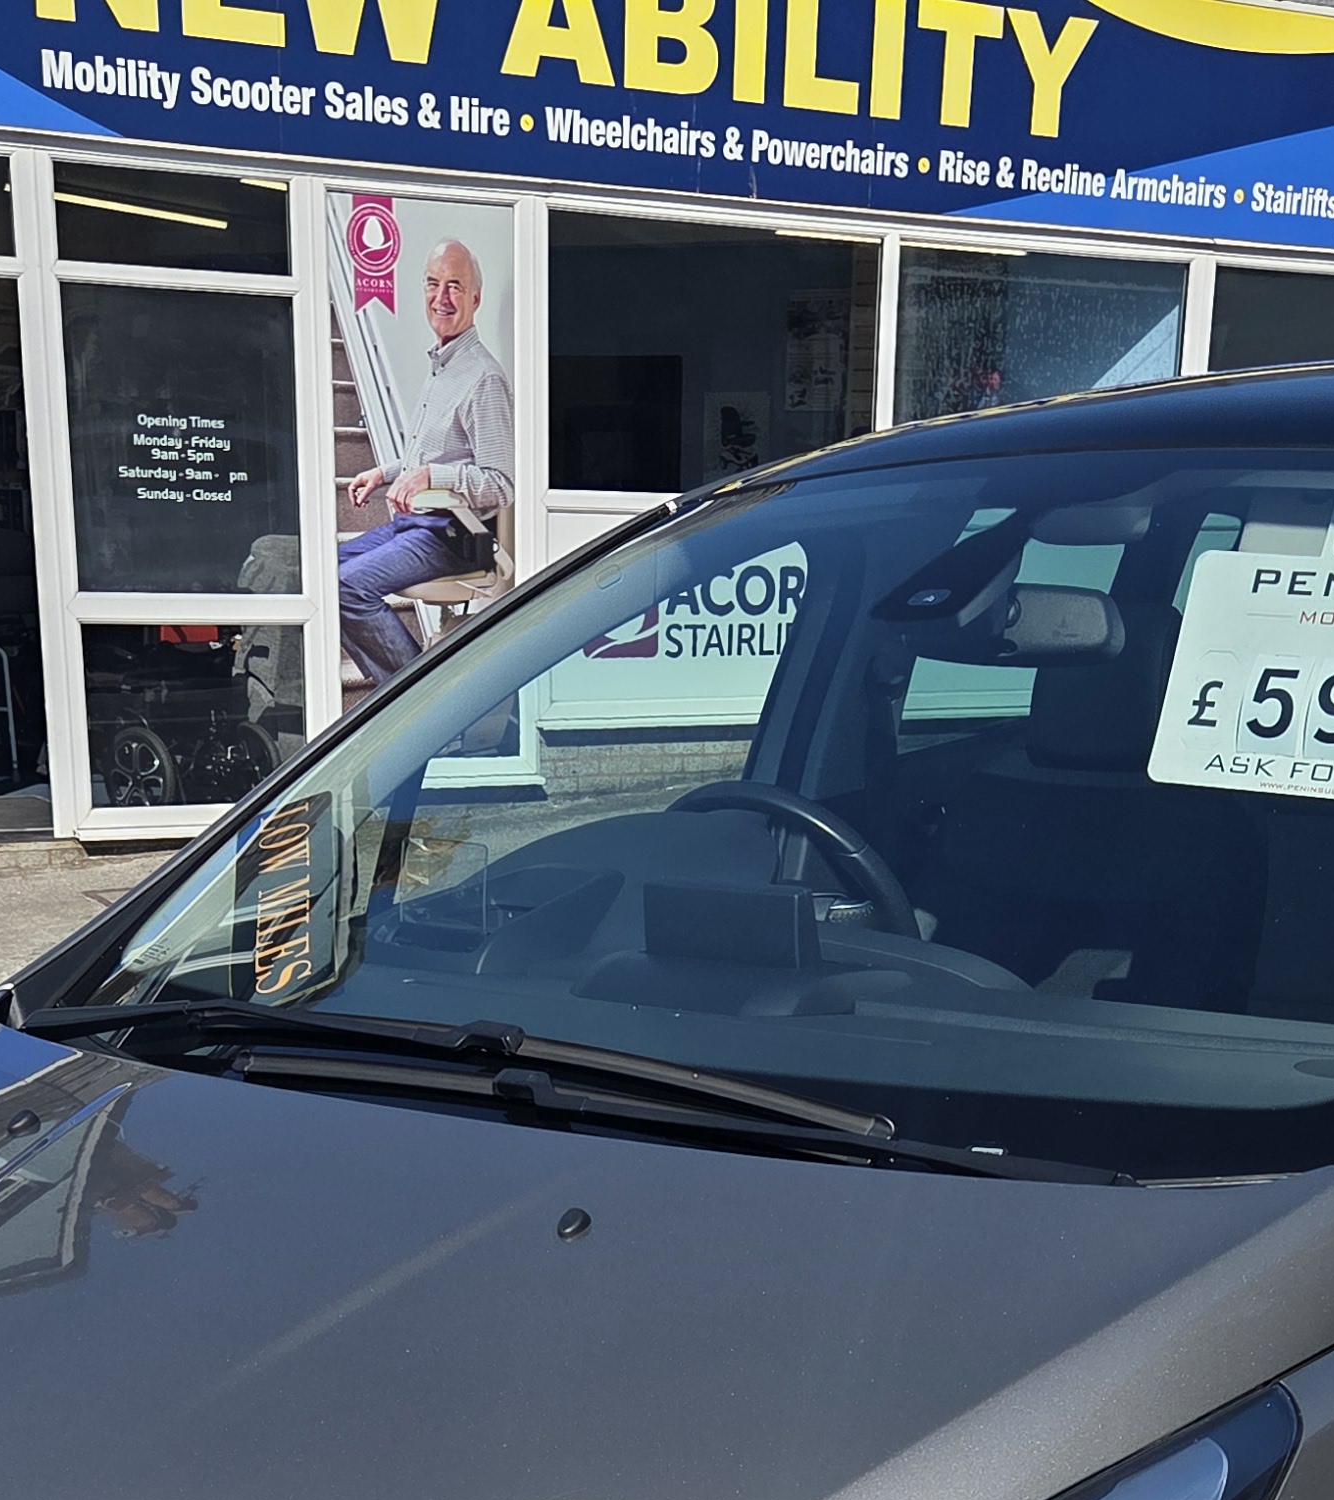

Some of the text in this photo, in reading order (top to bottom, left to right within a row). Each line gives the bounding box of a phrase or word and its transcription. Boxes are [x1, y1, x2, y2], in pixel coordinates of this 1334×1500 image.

[500, 0, 1099, 138] ABILITY
[41, 48, 181, 110] Mobility
[190, 66, 316, 116] Scooter
[324, 81, 409, 126] Sales
[417, 92, 441, 129] &
[450, 95, 510, 136] Hire
[544, 106, 716, 158] Wheelchairs
[722, 126, 744, 161] &
[751, 129, 909, 178] Powerchairs
[938, 149, 990, 186] Rise
[995, 156, 1015, 189] &
[1021, 158, 1106, 198] Recline
[1110, 168, 1227, 209] Armchairs
[356, 278, 393, 288] ACORN
[137, 413, 225, 430] Opening Times
[133, 433, 182, 449] Monday
[190, 435, 231, 451] Friday
[150, 448, 179, 461] 9am
[186, 449, 215, 464] 5pm
[118, 465, 177, 482] Saturday
[185, 468, 213, 480] 9am
[136, 487, 185, 503] Sunday
[192, 488, 232, 502] Closed
[665, 566, 805, 616] ACOR
[665, 622, 794, 657] STAIRLI
[1187, 680, 1224, 728] £
[1204, 754, 1275, 777] ASK
[255, 874, 312, 994] MILES
